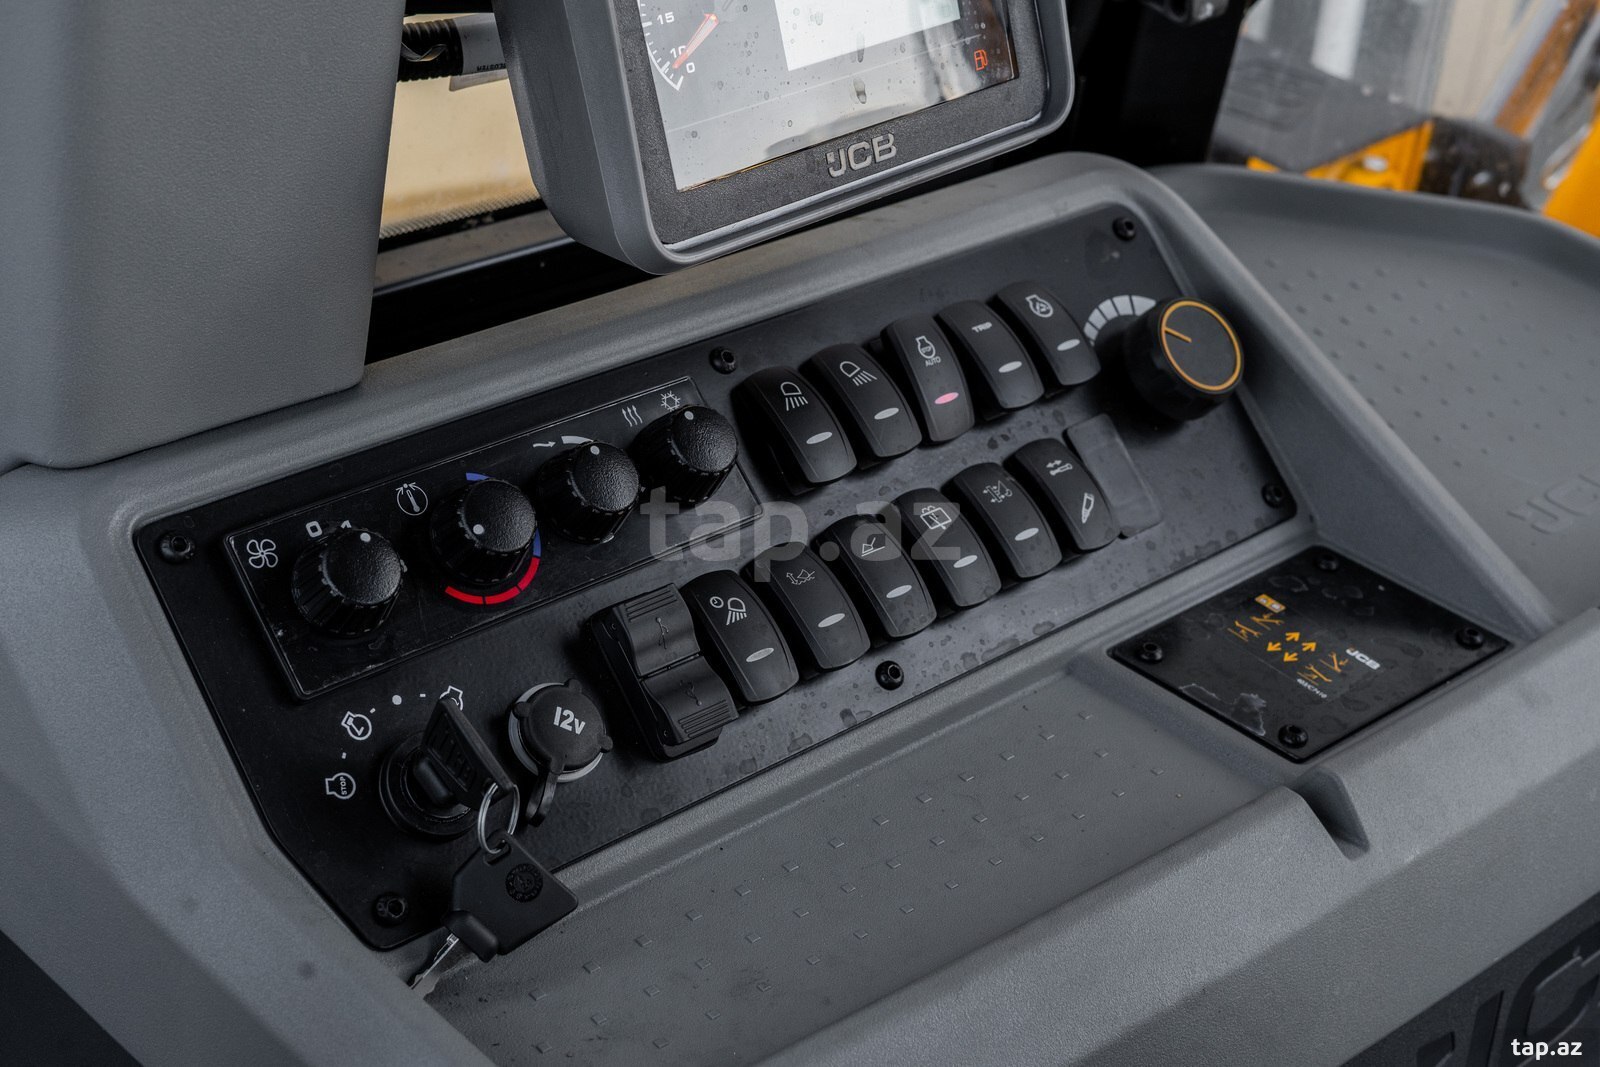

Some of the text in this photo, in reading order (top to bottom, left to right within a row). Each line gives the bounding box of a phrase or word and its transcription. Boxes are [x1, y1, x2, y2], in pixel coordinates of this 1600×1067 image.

[656, 11, 675, 25] 15
[685, 61, 696, 74] 0
[825, 132, 897, 178] JCB
[971, 321, 993, 333] TRIP
[924, 355, 942, 367] AUTO
[1345, 646, 1381, 671] JCB
[339, 775, 349, 796] STOP
